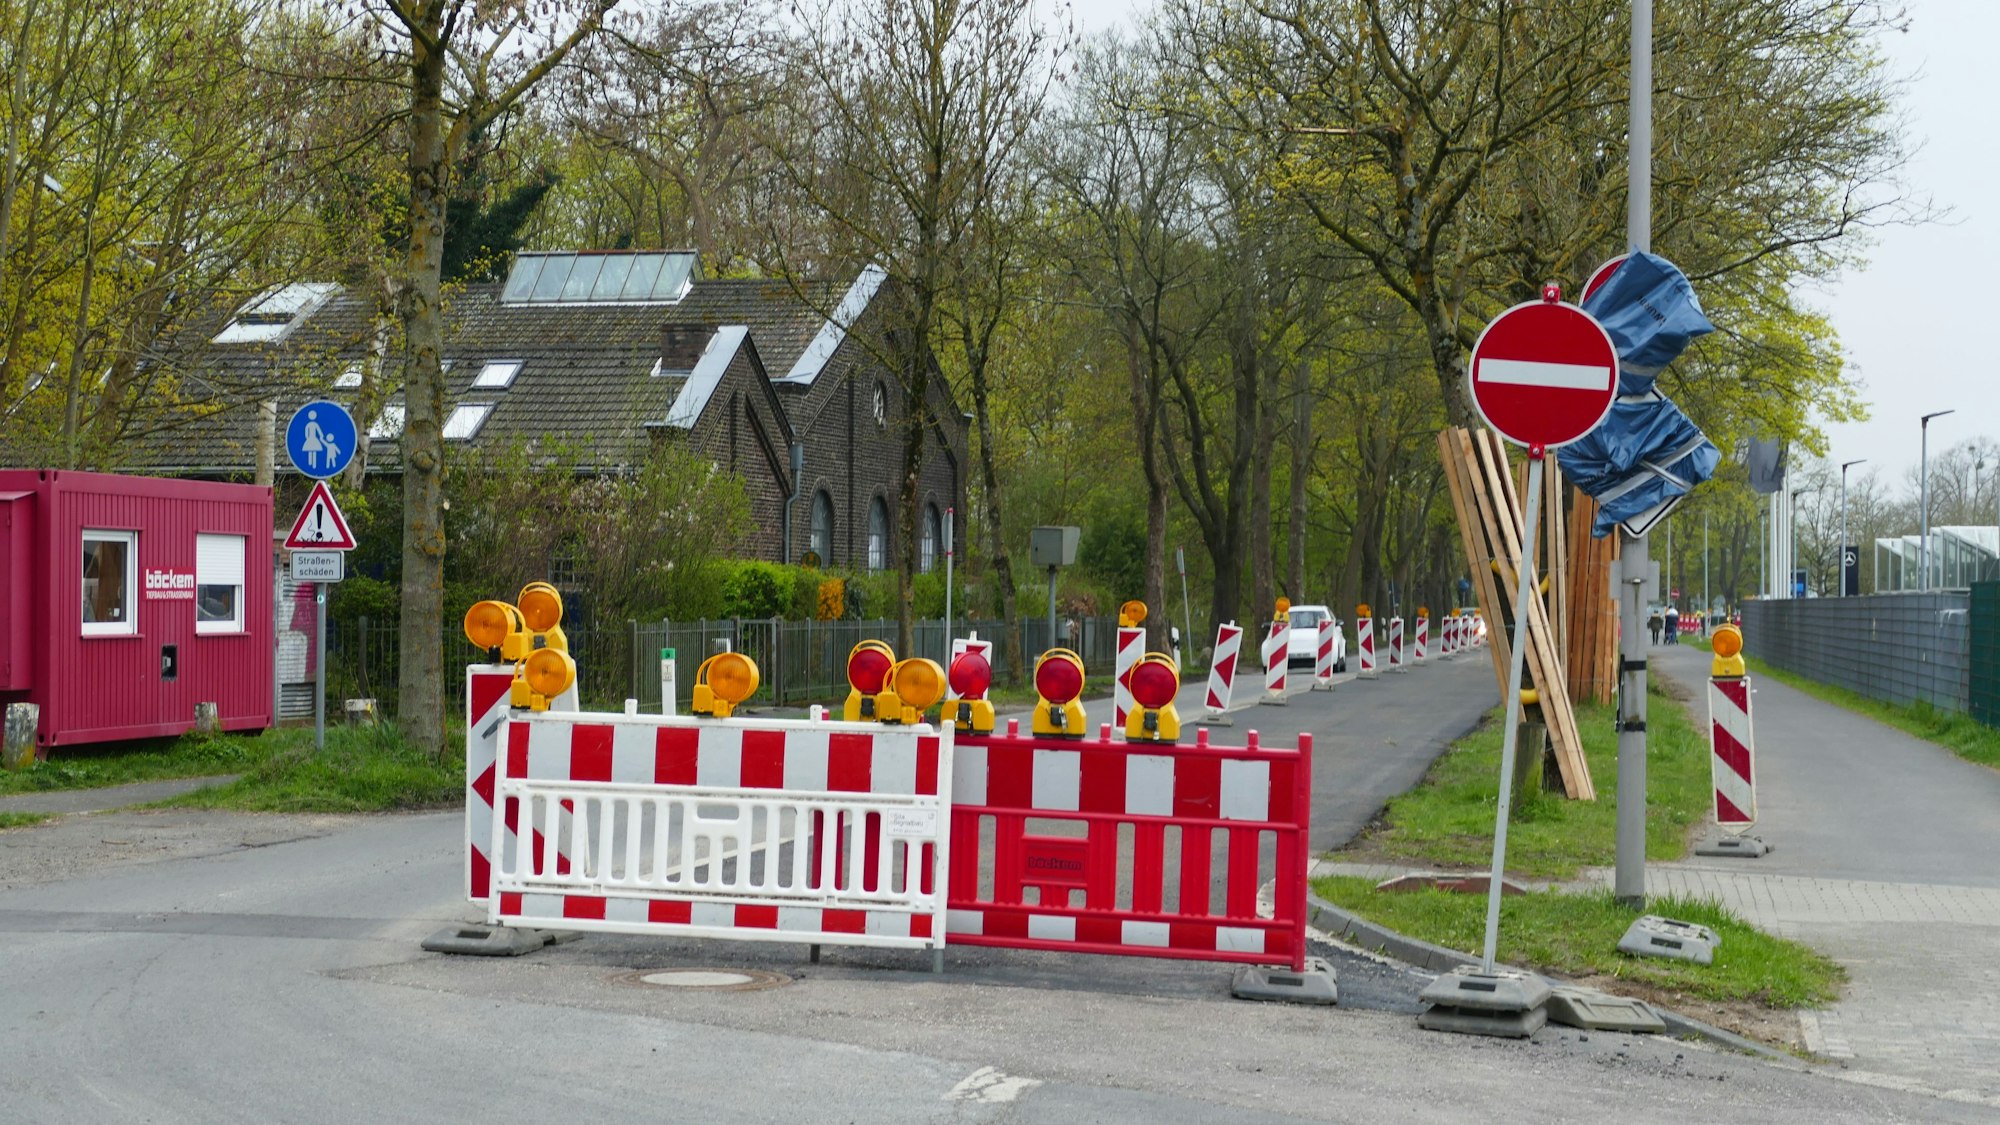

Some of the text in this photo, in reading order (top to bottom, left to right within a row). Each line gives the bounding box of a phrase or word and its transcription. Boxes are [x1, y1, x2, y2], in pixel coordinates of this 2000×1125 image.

[298, 556, 336, 565] Straßen-
[299, 568, 334, 576] schäden
[146, 569, 194, 589] böckem
